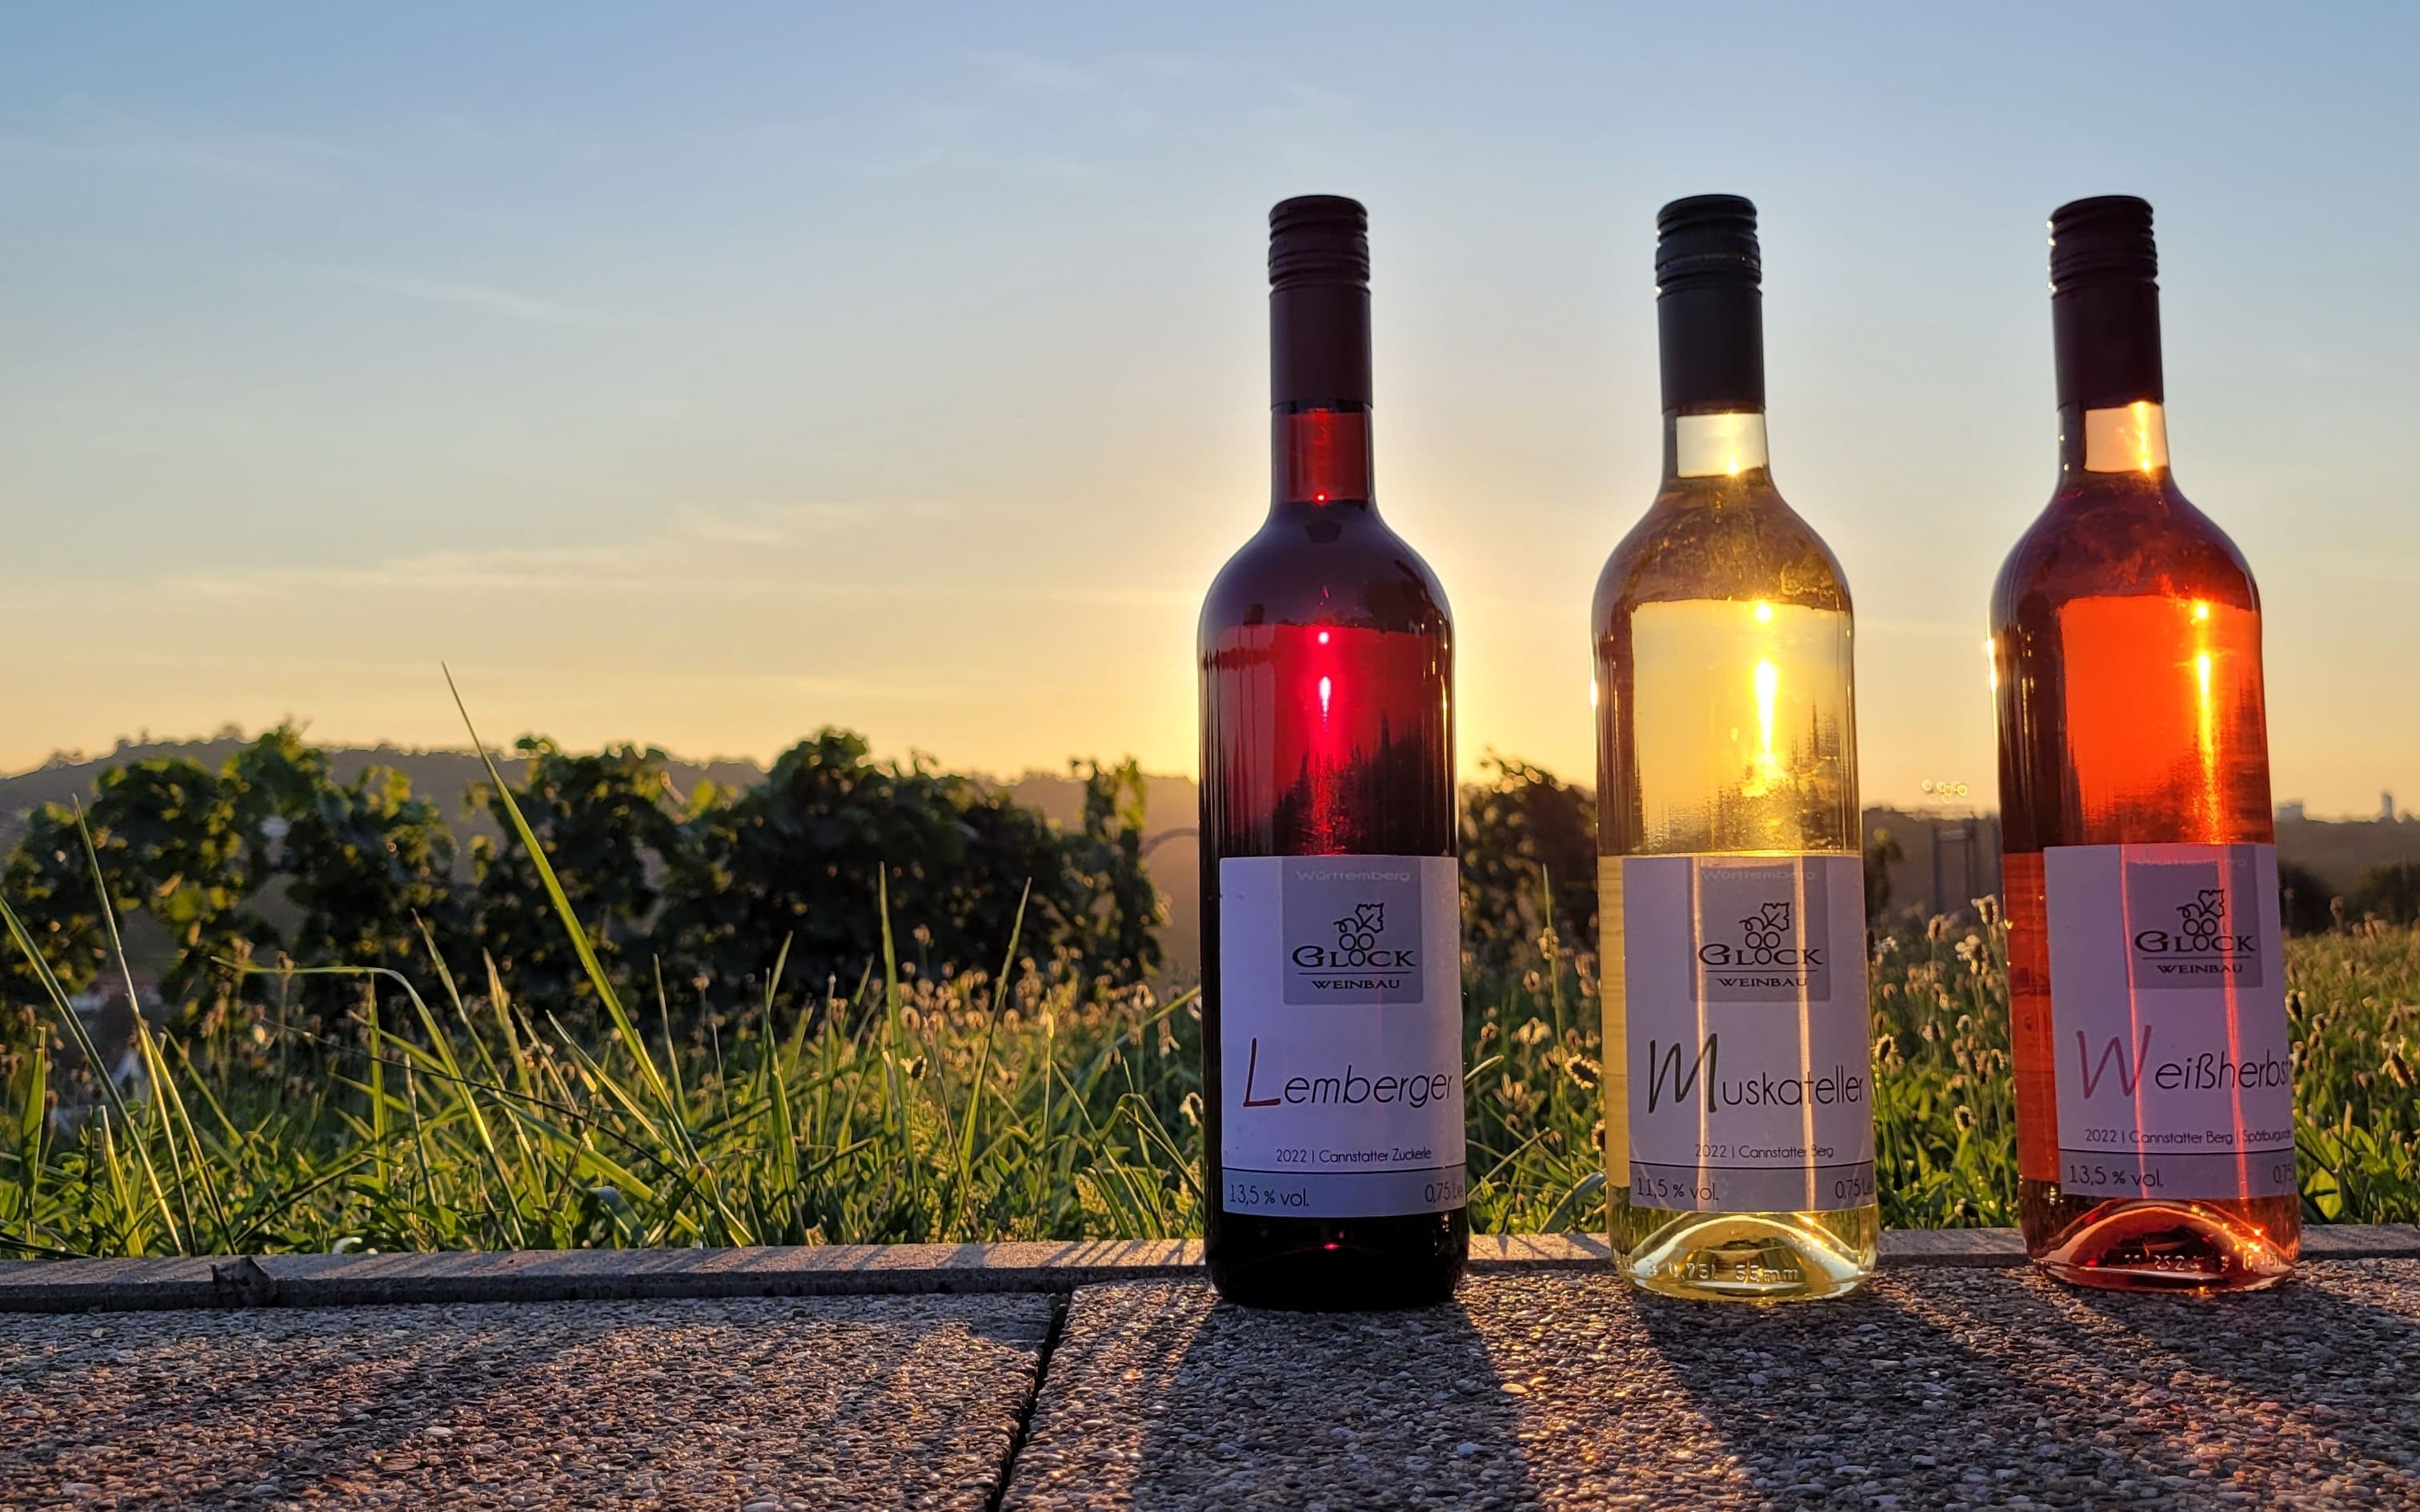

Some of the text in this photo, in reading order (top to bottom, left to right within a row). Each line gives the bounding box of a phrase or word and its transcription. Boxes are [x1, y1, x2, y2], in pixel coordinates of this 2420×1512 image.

[1701, 870, 1817, 882] Württembg
[2157, 964, 2243, 974] WEINBAU
[1312, 979, 1400, 990] WEINBAU
[1717, 978, 1809, 988] WEINBAU
[1243, 1037, 1453, 1109] Lemberger
[1649, 1032, 1863, 1114] Muskateller
[2085, 1129, 2117, 1142] 2022
[2129, 1130, 2202, 1144] Cannstatter
[2206, 1130, 2233, 1145] Berg
[1276, 1149, 1307, 1162] 2022
[1319, 1149, 1388, 1163] Cannstatter
[1392, 1146, 1432, 1161] Zuckerle
[1695, 1144, 1726, 1158] 2022
[1738, 1144, 1807, 1158] Cannstatter
[1810, 1144, 1834, 1158] Berg
[2069, 1166, 2164, 1188] 13,5 % vol.
[1230, 1184, 1309, 1207] 13,5 % vol.
[1637, 1178, 1719, 1201] 11,5 % vol.
